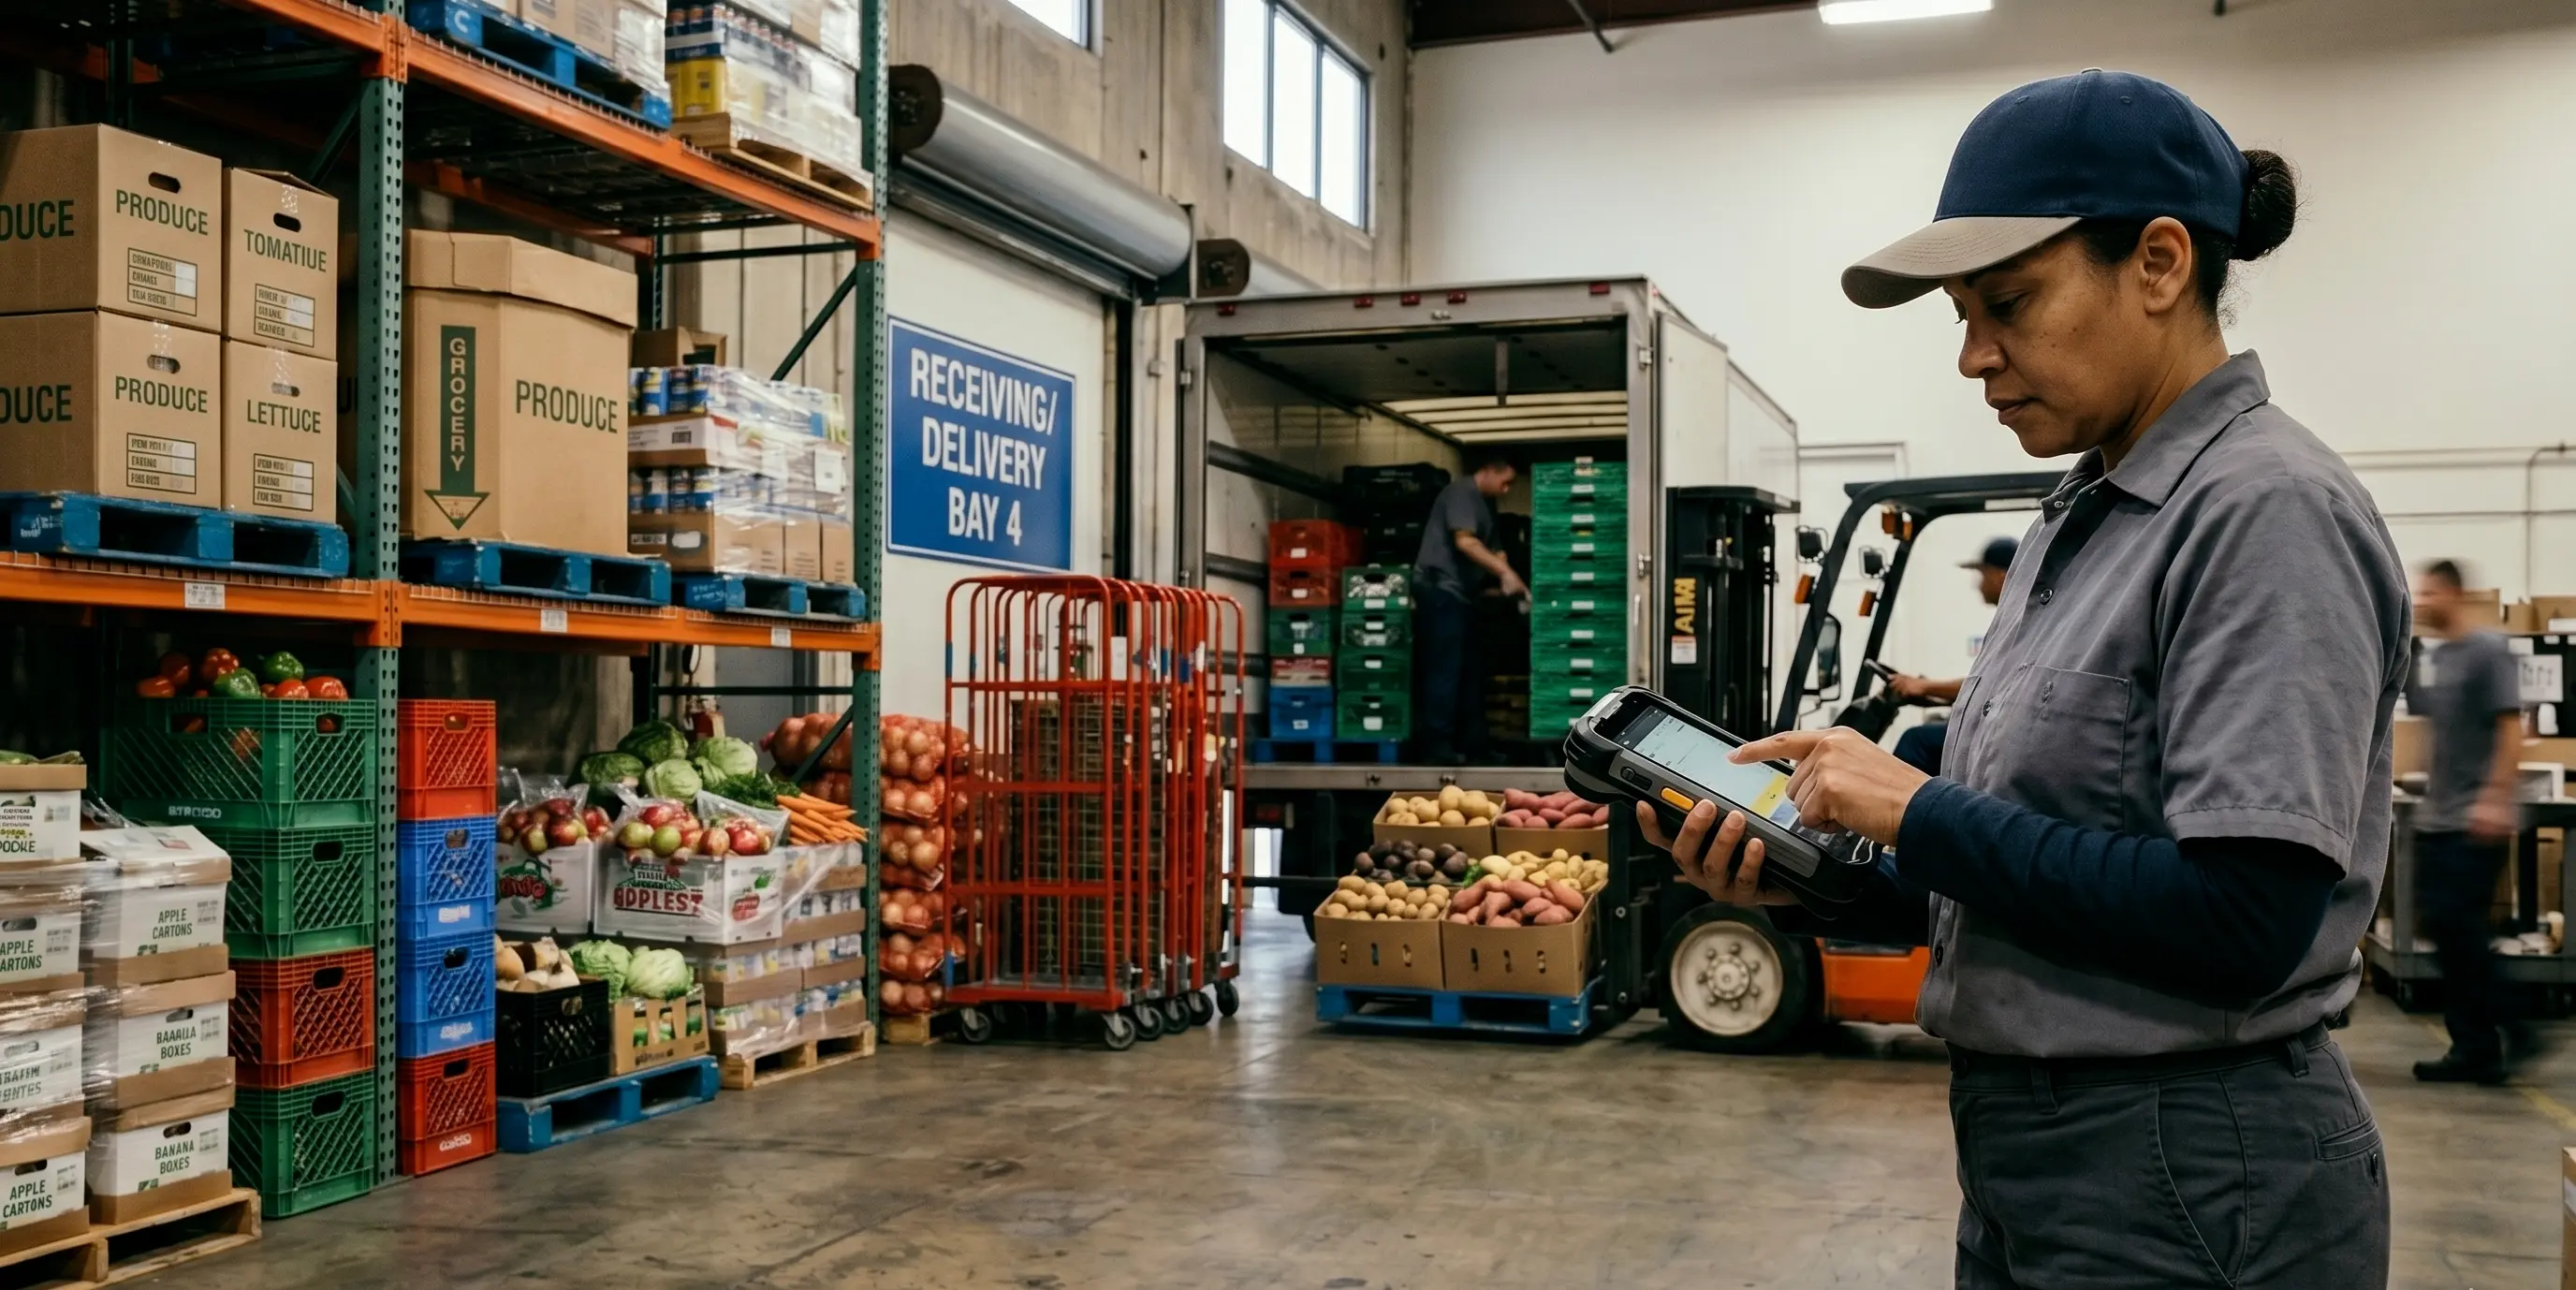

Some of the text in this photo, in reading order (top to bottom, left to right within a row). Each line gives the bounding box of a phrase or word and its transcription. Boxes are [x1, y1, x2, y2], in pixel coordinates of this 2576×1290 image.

[115, 189, 209, 236] PRODUCE
[114, 376, 208, 413] PRODUCE
[450, 338, 466, 472] GROCERY
[911, 347, 1058, 435] RECEIVING/
[247, 400, 321, 434] LETTUCE
[516, 379, 618, 433] PRODUCE
[922, 416, 1046, 491] DELIVERY
[947, 487, 1022, 547] BAY 4
[158, 909, 187, 924] APPLE
[153, 923, 193, 940] CARTONS
[0, 940, 34, 955] APPLE
[160, 1043, 192, 1060] BOXES
[154, 1140, 195, 1161] BANANA
[160, 1155, 190, 1174] BOXES
[9, 1180, 46, 1200] APPLE
[3, 1195, 52, 1218] CARTONS
